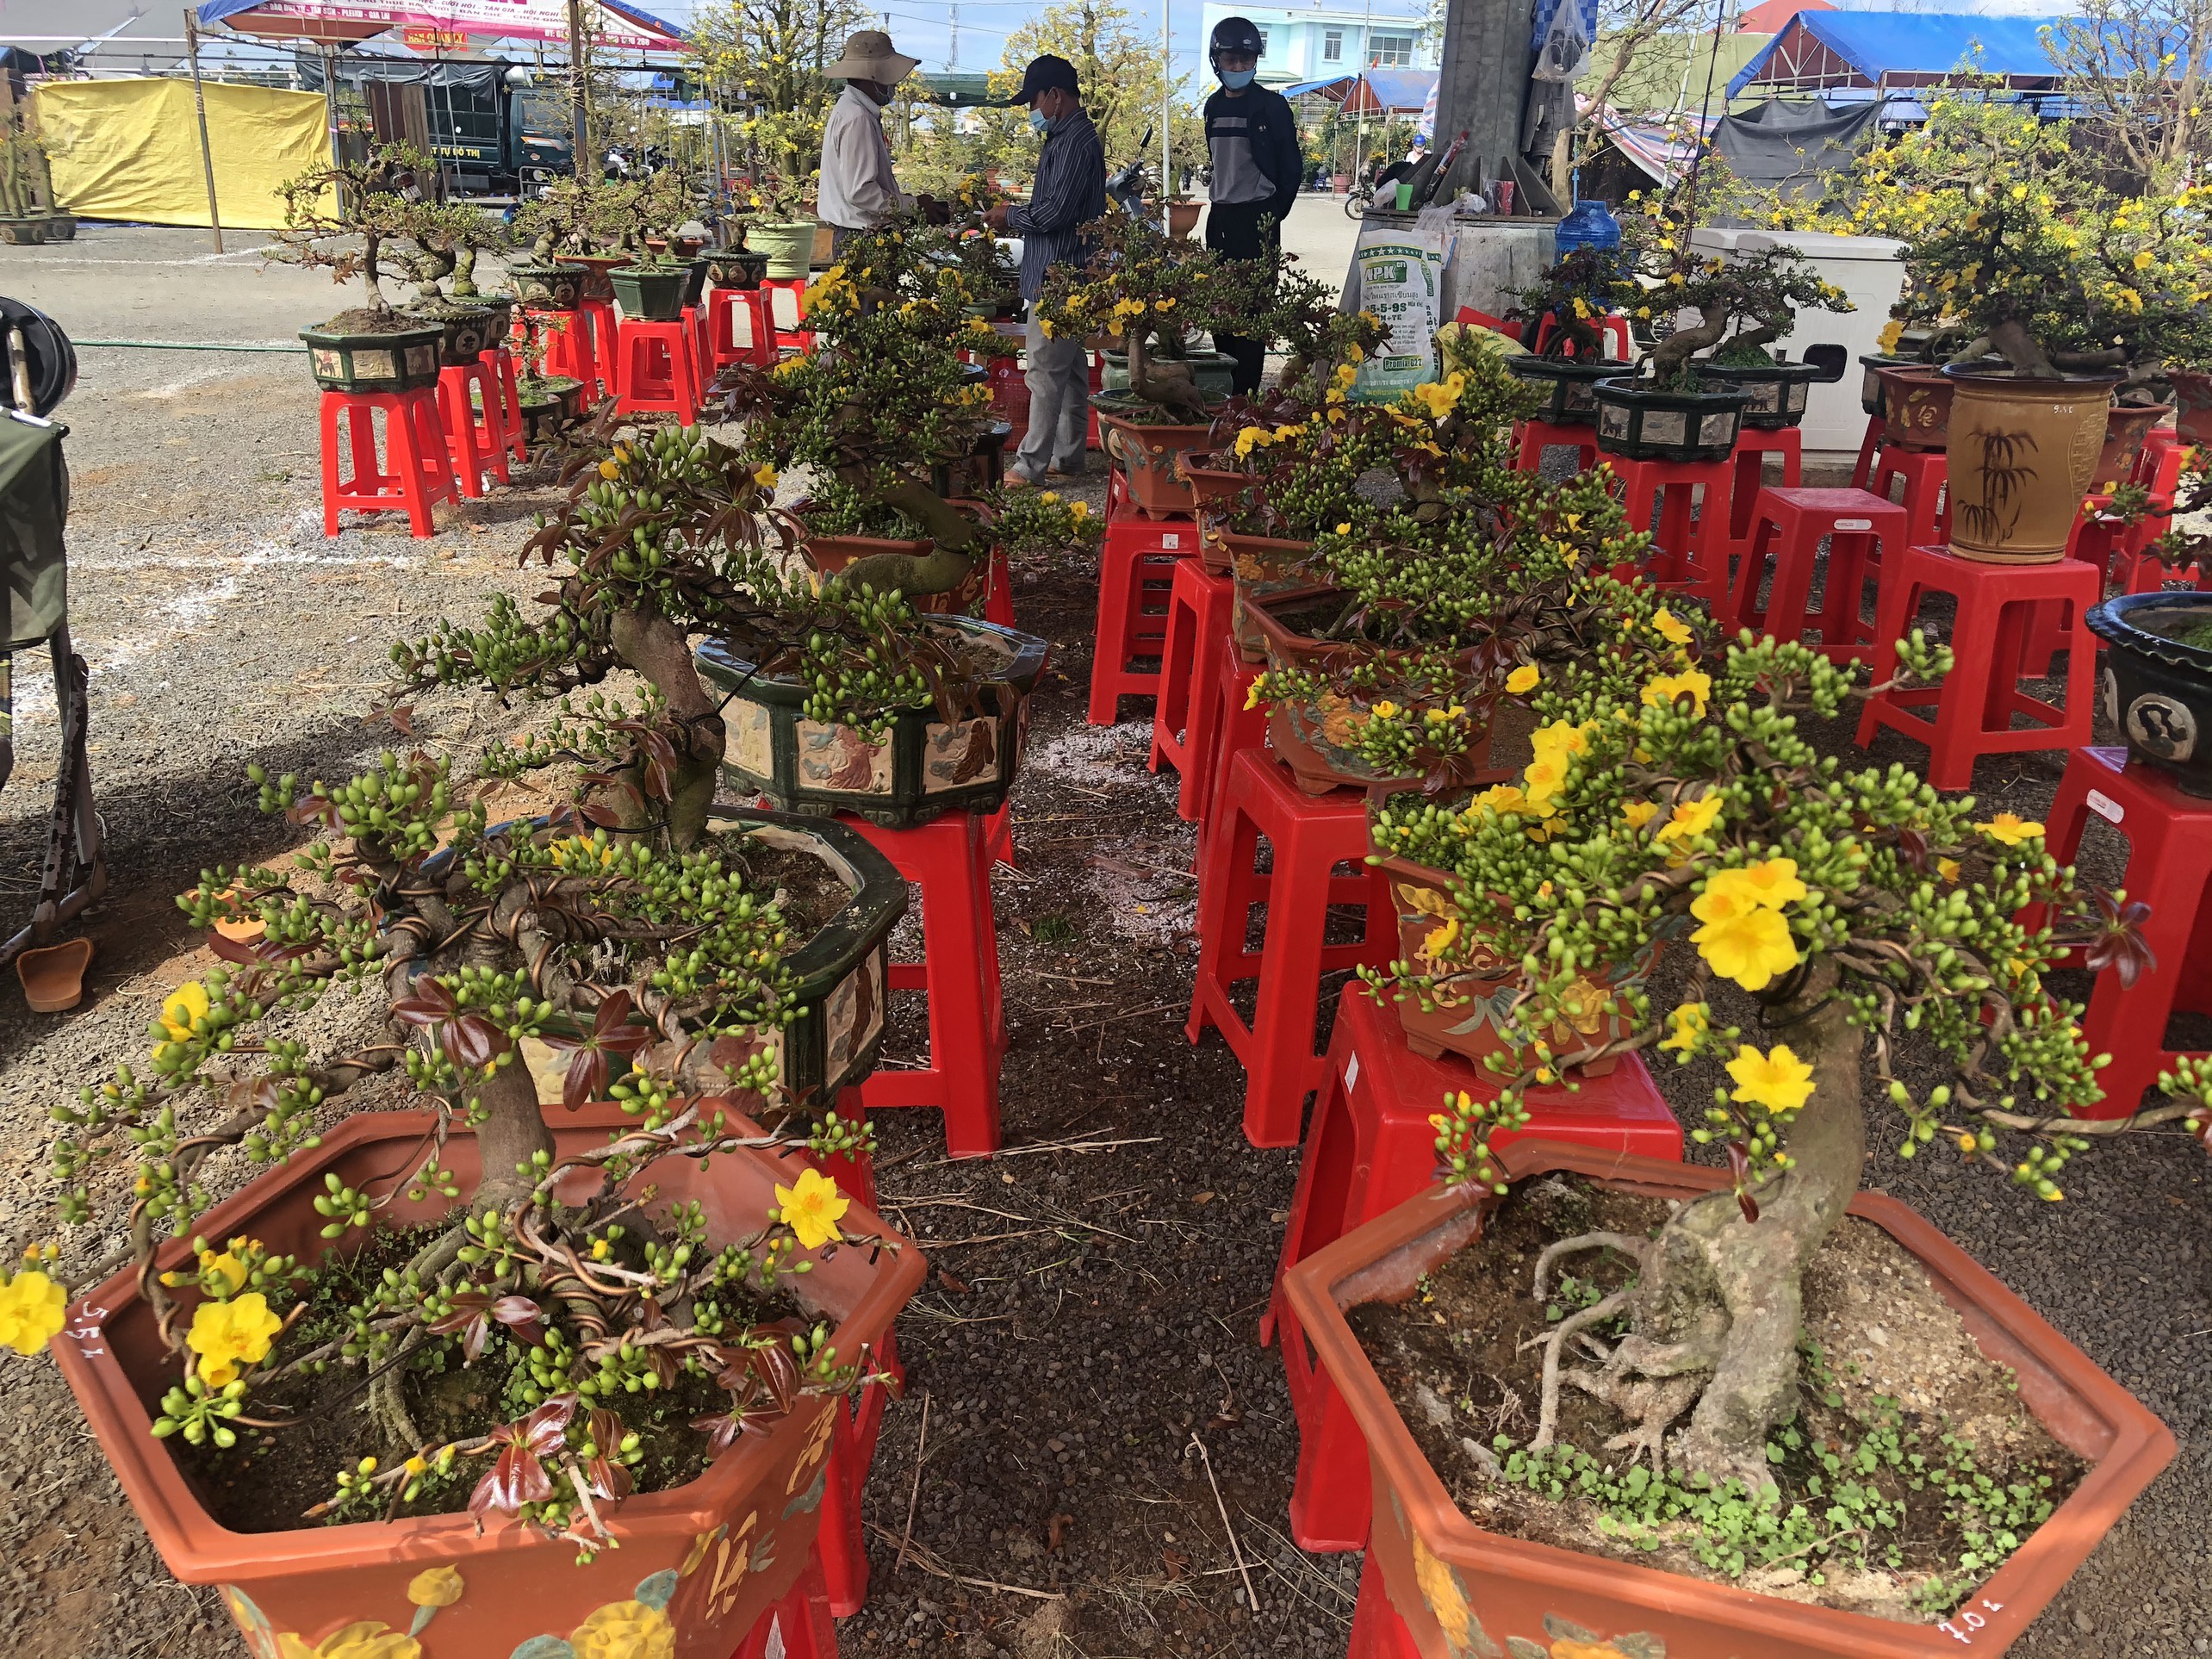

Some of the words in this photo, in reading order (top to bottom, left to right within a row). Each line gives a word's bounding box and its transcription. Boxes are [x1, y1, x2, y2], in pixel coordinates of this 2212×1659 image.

[341, 9, 363, 18] PLEIKU
[369, 11, 381, 20] GIA
[465, 148, 480, 159] THỊ
